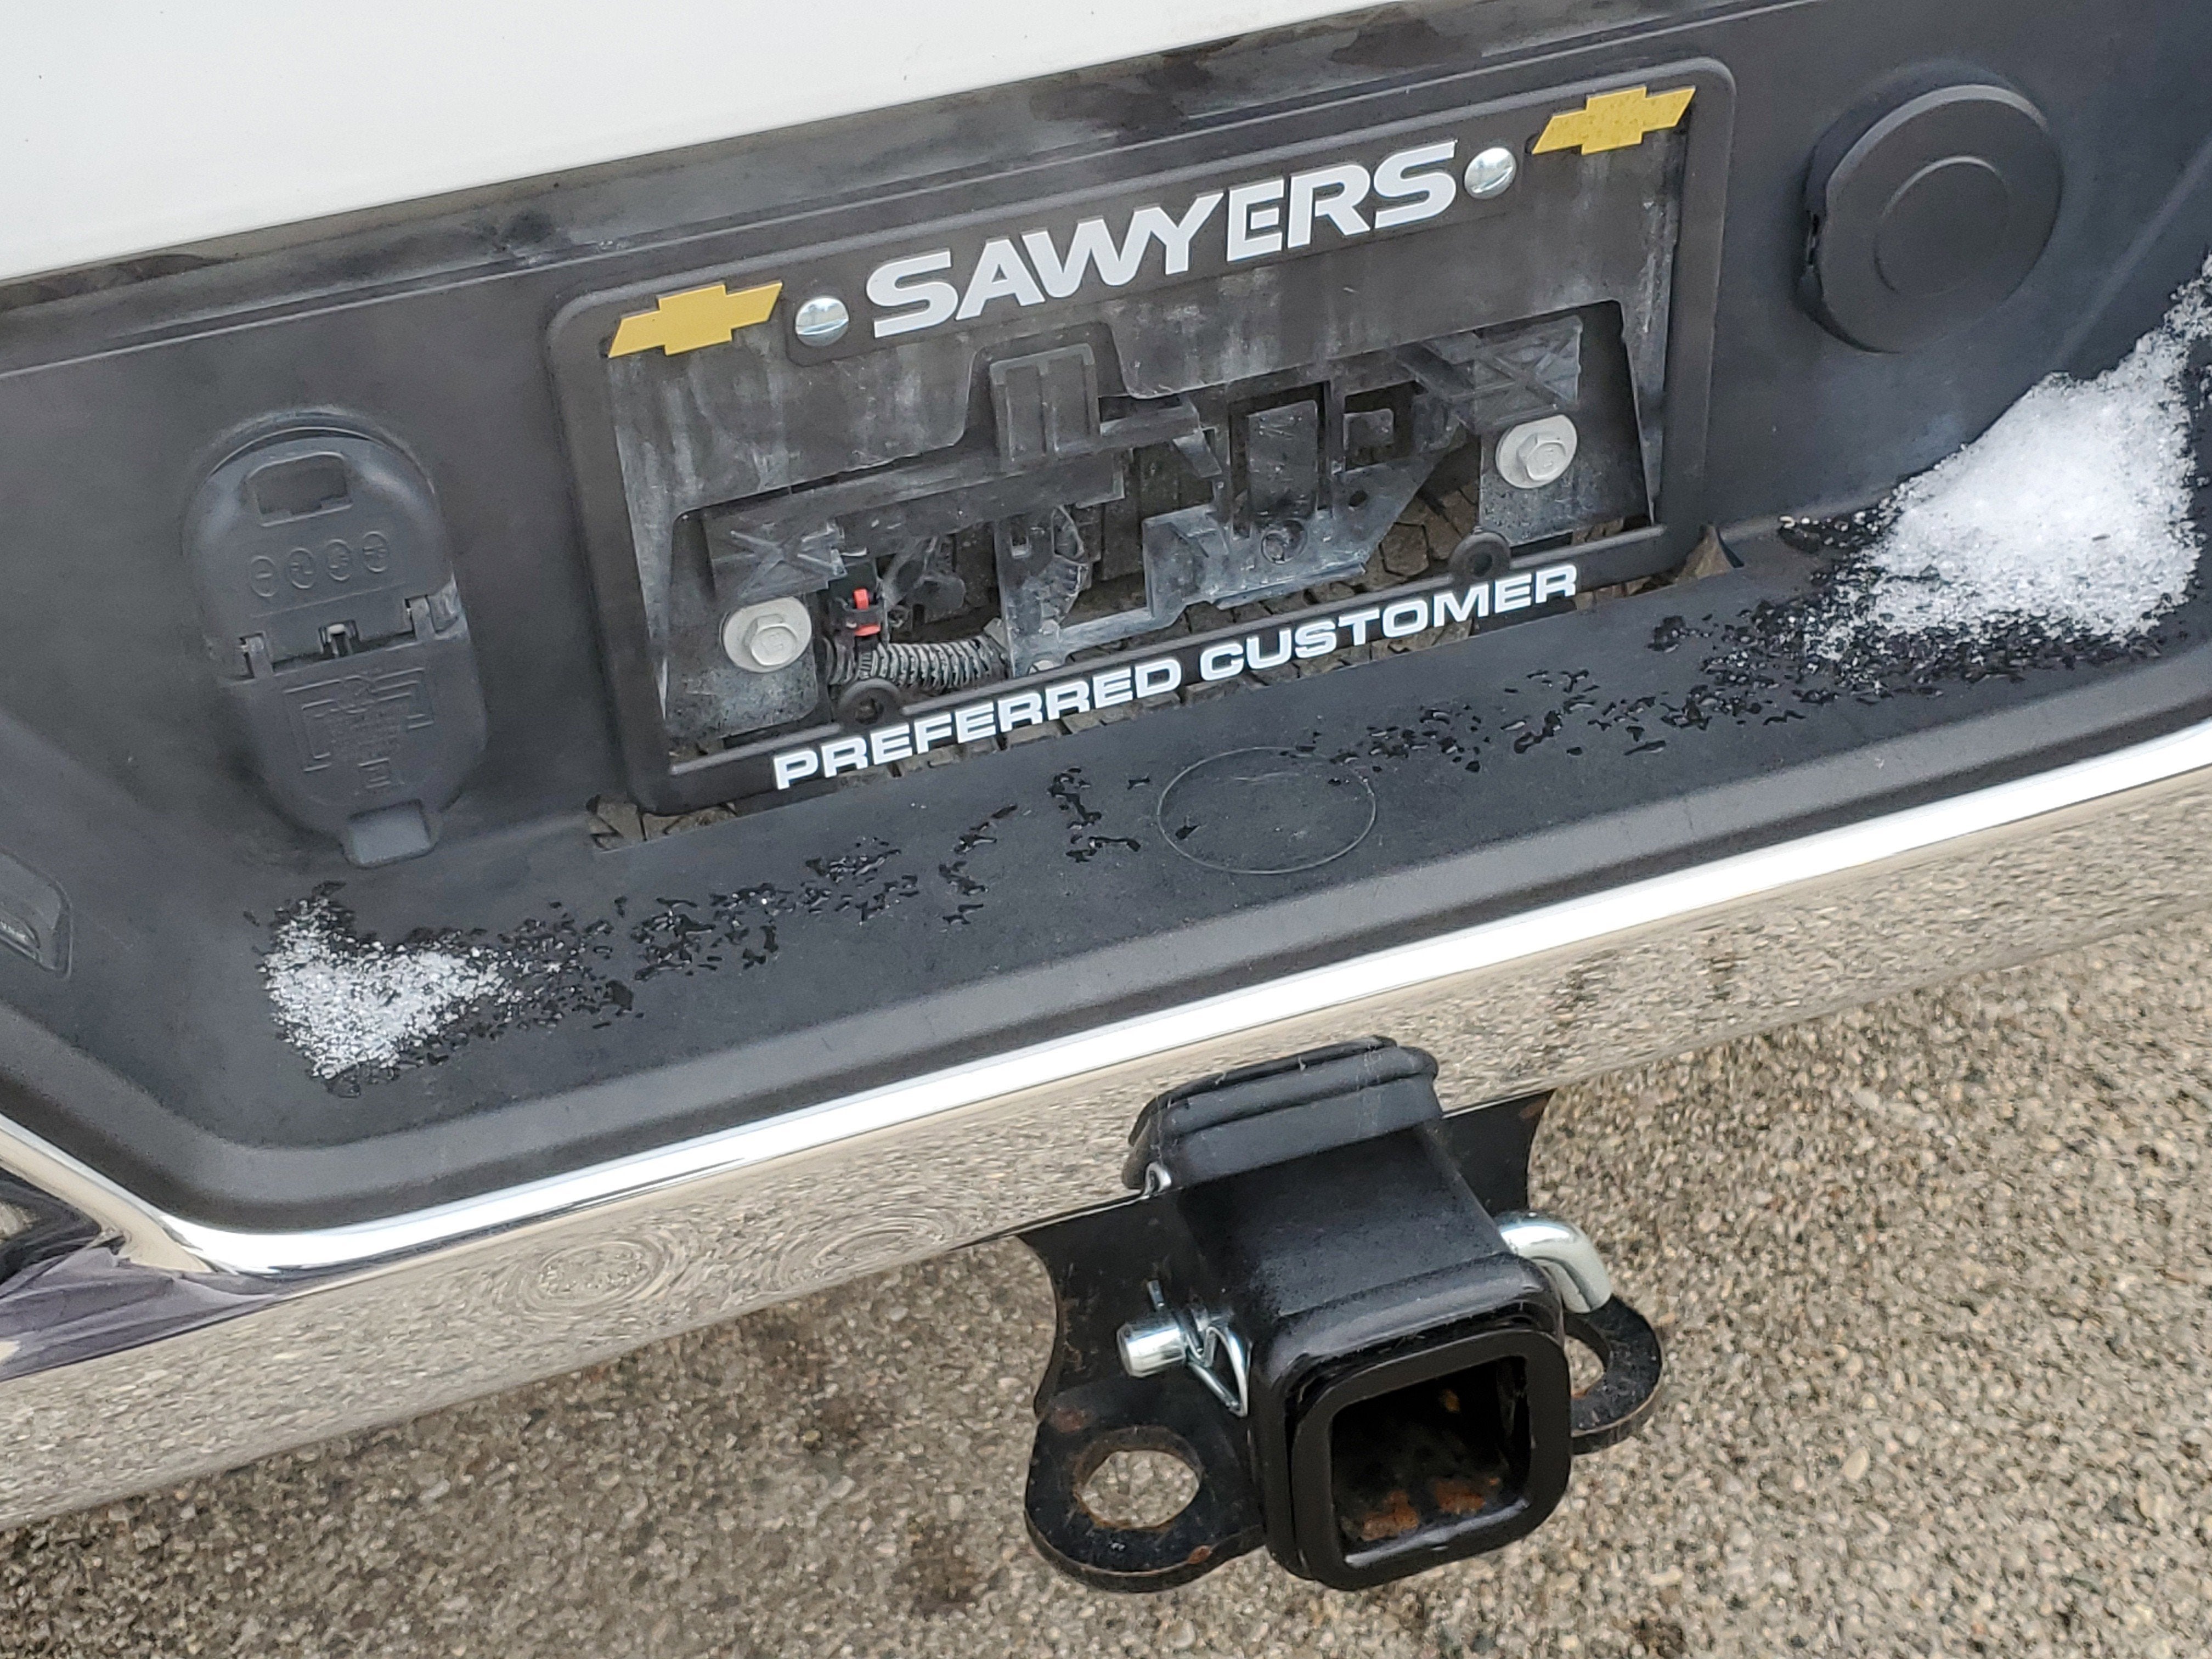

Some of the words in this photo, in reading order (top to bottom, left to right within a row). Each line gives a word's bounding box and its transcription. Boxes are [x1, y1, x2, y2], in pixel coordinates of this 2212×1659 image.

[866, 139, 1458, 338] SAWYERS
[773, 658, 1181, 790] PREFERRED
[1200, 564, 1577, 681] CUSTOMER
